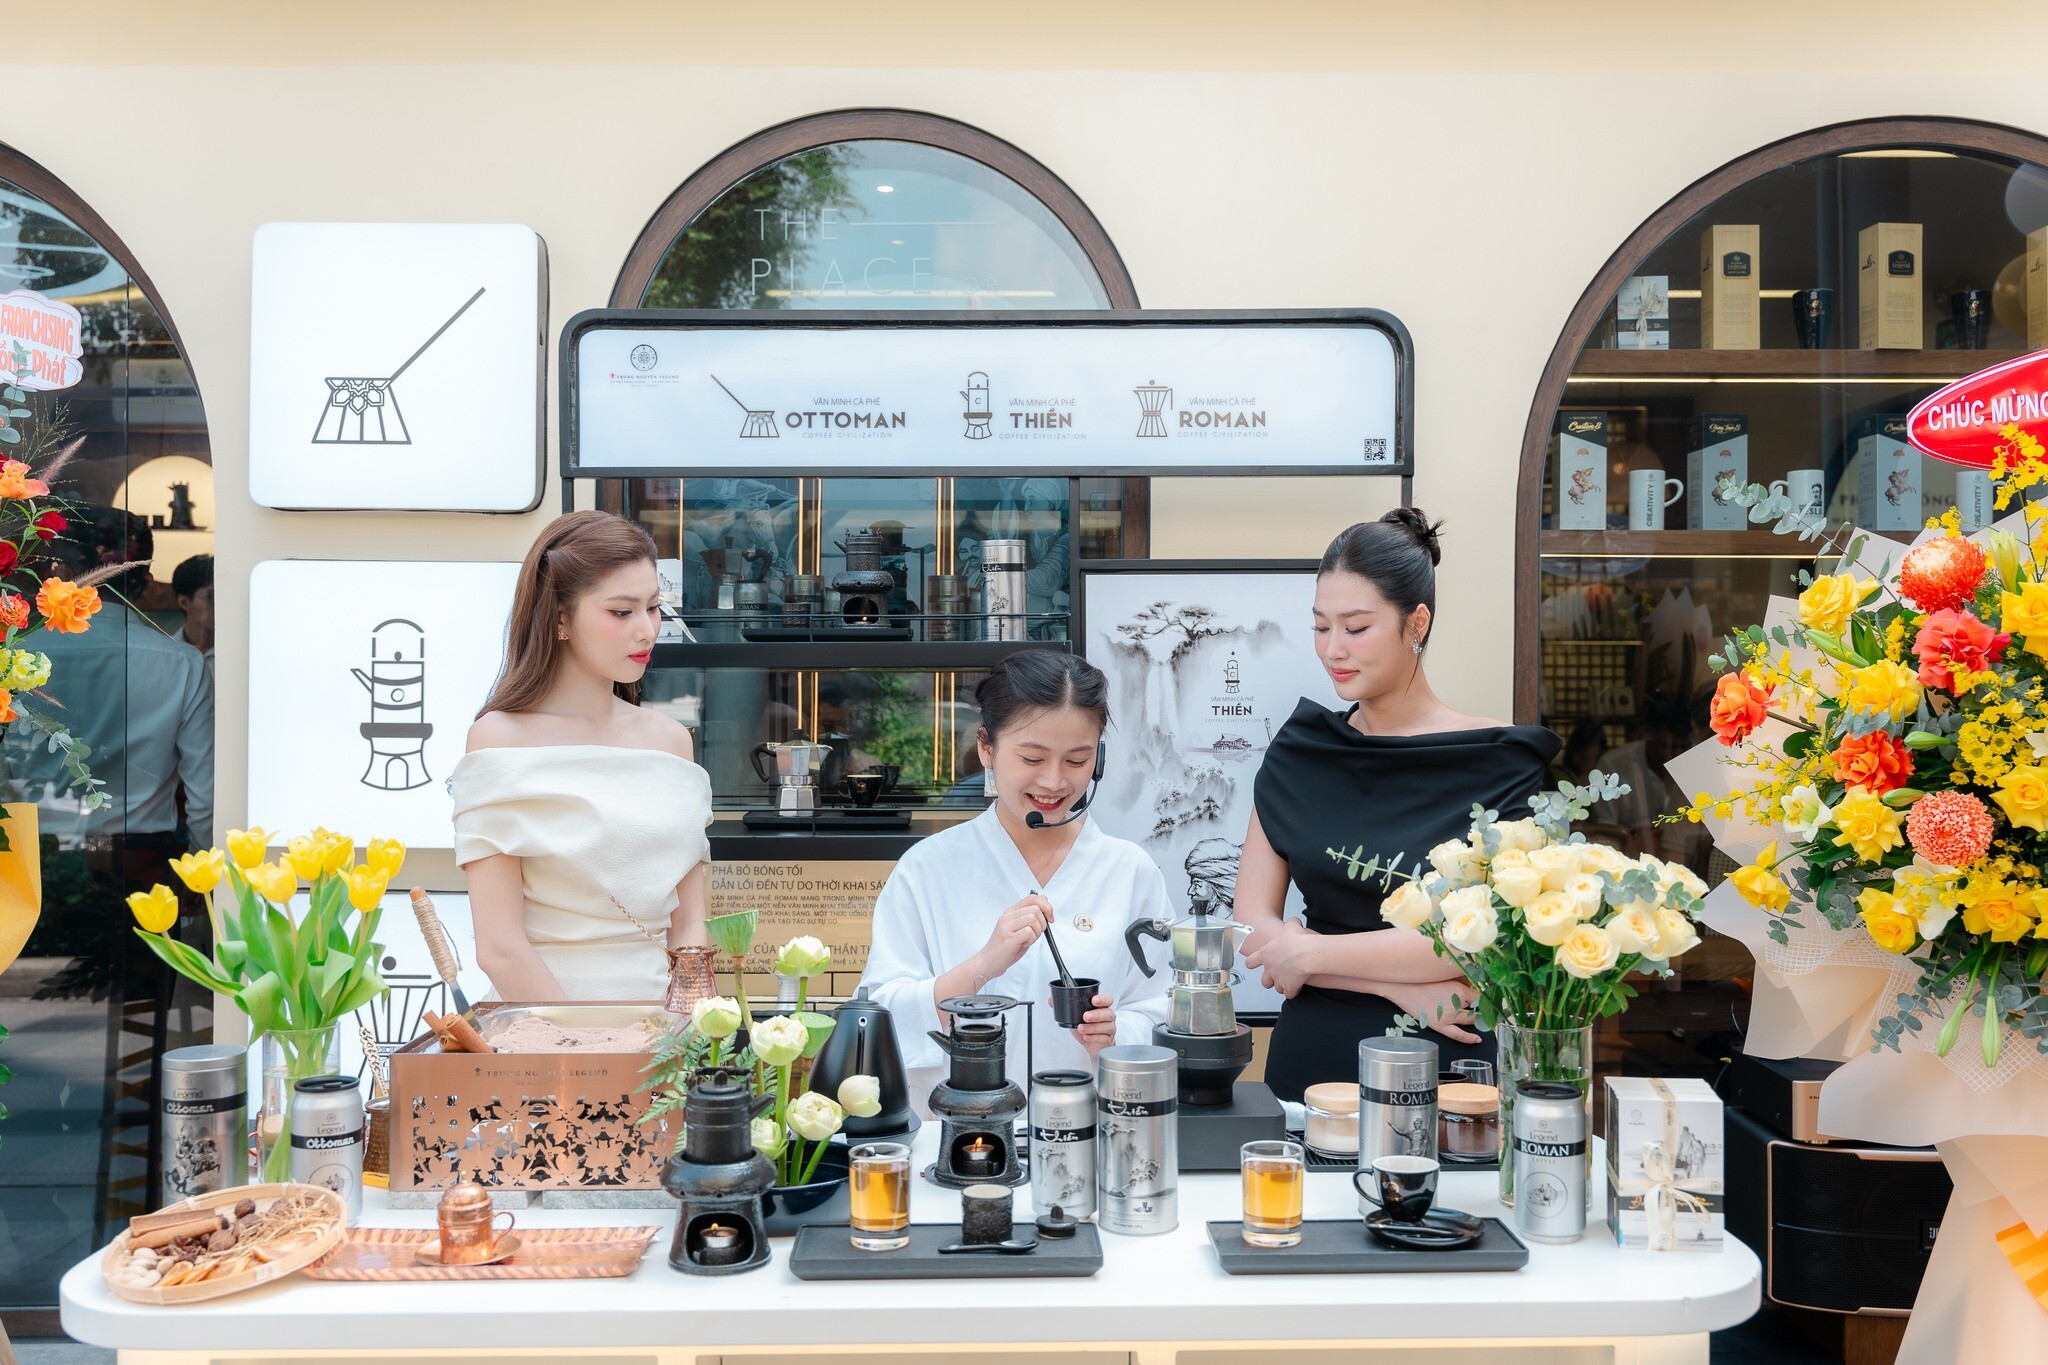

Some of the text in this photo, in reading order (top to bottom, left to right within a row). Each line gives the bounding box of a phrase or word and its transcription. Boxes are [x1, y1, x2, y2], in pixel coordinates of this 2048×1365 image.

[754, 208, 838, 241] THE
[751, 257, 932, 296] PLACE
[1, 304, 74, 355] FRANCHISING
[32, 349, 67, 386] Phát
[831, 398, 852, 406] MINH
[1026, 398, 1047, 407] MINH
[1206, 398, 1227, 406] MINH
[1009, 408, 1072, 429] THIỀN
[1179, 411, 1266, 428] ROMAN
[1928, 395, 1985, 431] CHÚC
[785, 411, 906, 429] OTTOMAN
[1646, 484, 1654, 527] CREATIVITY
[712, 863, 803, 876] PHÁ BỎ BÓNG TỐI
[737, 878, 754, 890] LỐI
[756, 878, 778, 890] ĐẾN
[780, 880, 795, 892] TỰ
[797, 881, 813, 890] DO
[815, 879, 840, 890] THỜI
[843, 881, 867, 890] KHAI
[753, 942, 777, 954] CỦA
[1403, 1079, 1430, 1090] Legend
[173, 1090, 203, 1100] Legend
[1112, 1090, 1142, 1100] Legend
[1389, 1090, 1437, 1105] ROMAN
[166, 1102, 215, 1113] Ottoman
[317, 1124, 346, 1135] Legend
[1045, 1120, 1072, 1128] Legend
[306, 1136, 355, 1149] Ottoman
[1529, 1132, 1558, 1142] Legend
[1520, 1140, 1570, 1156] ROMAN
